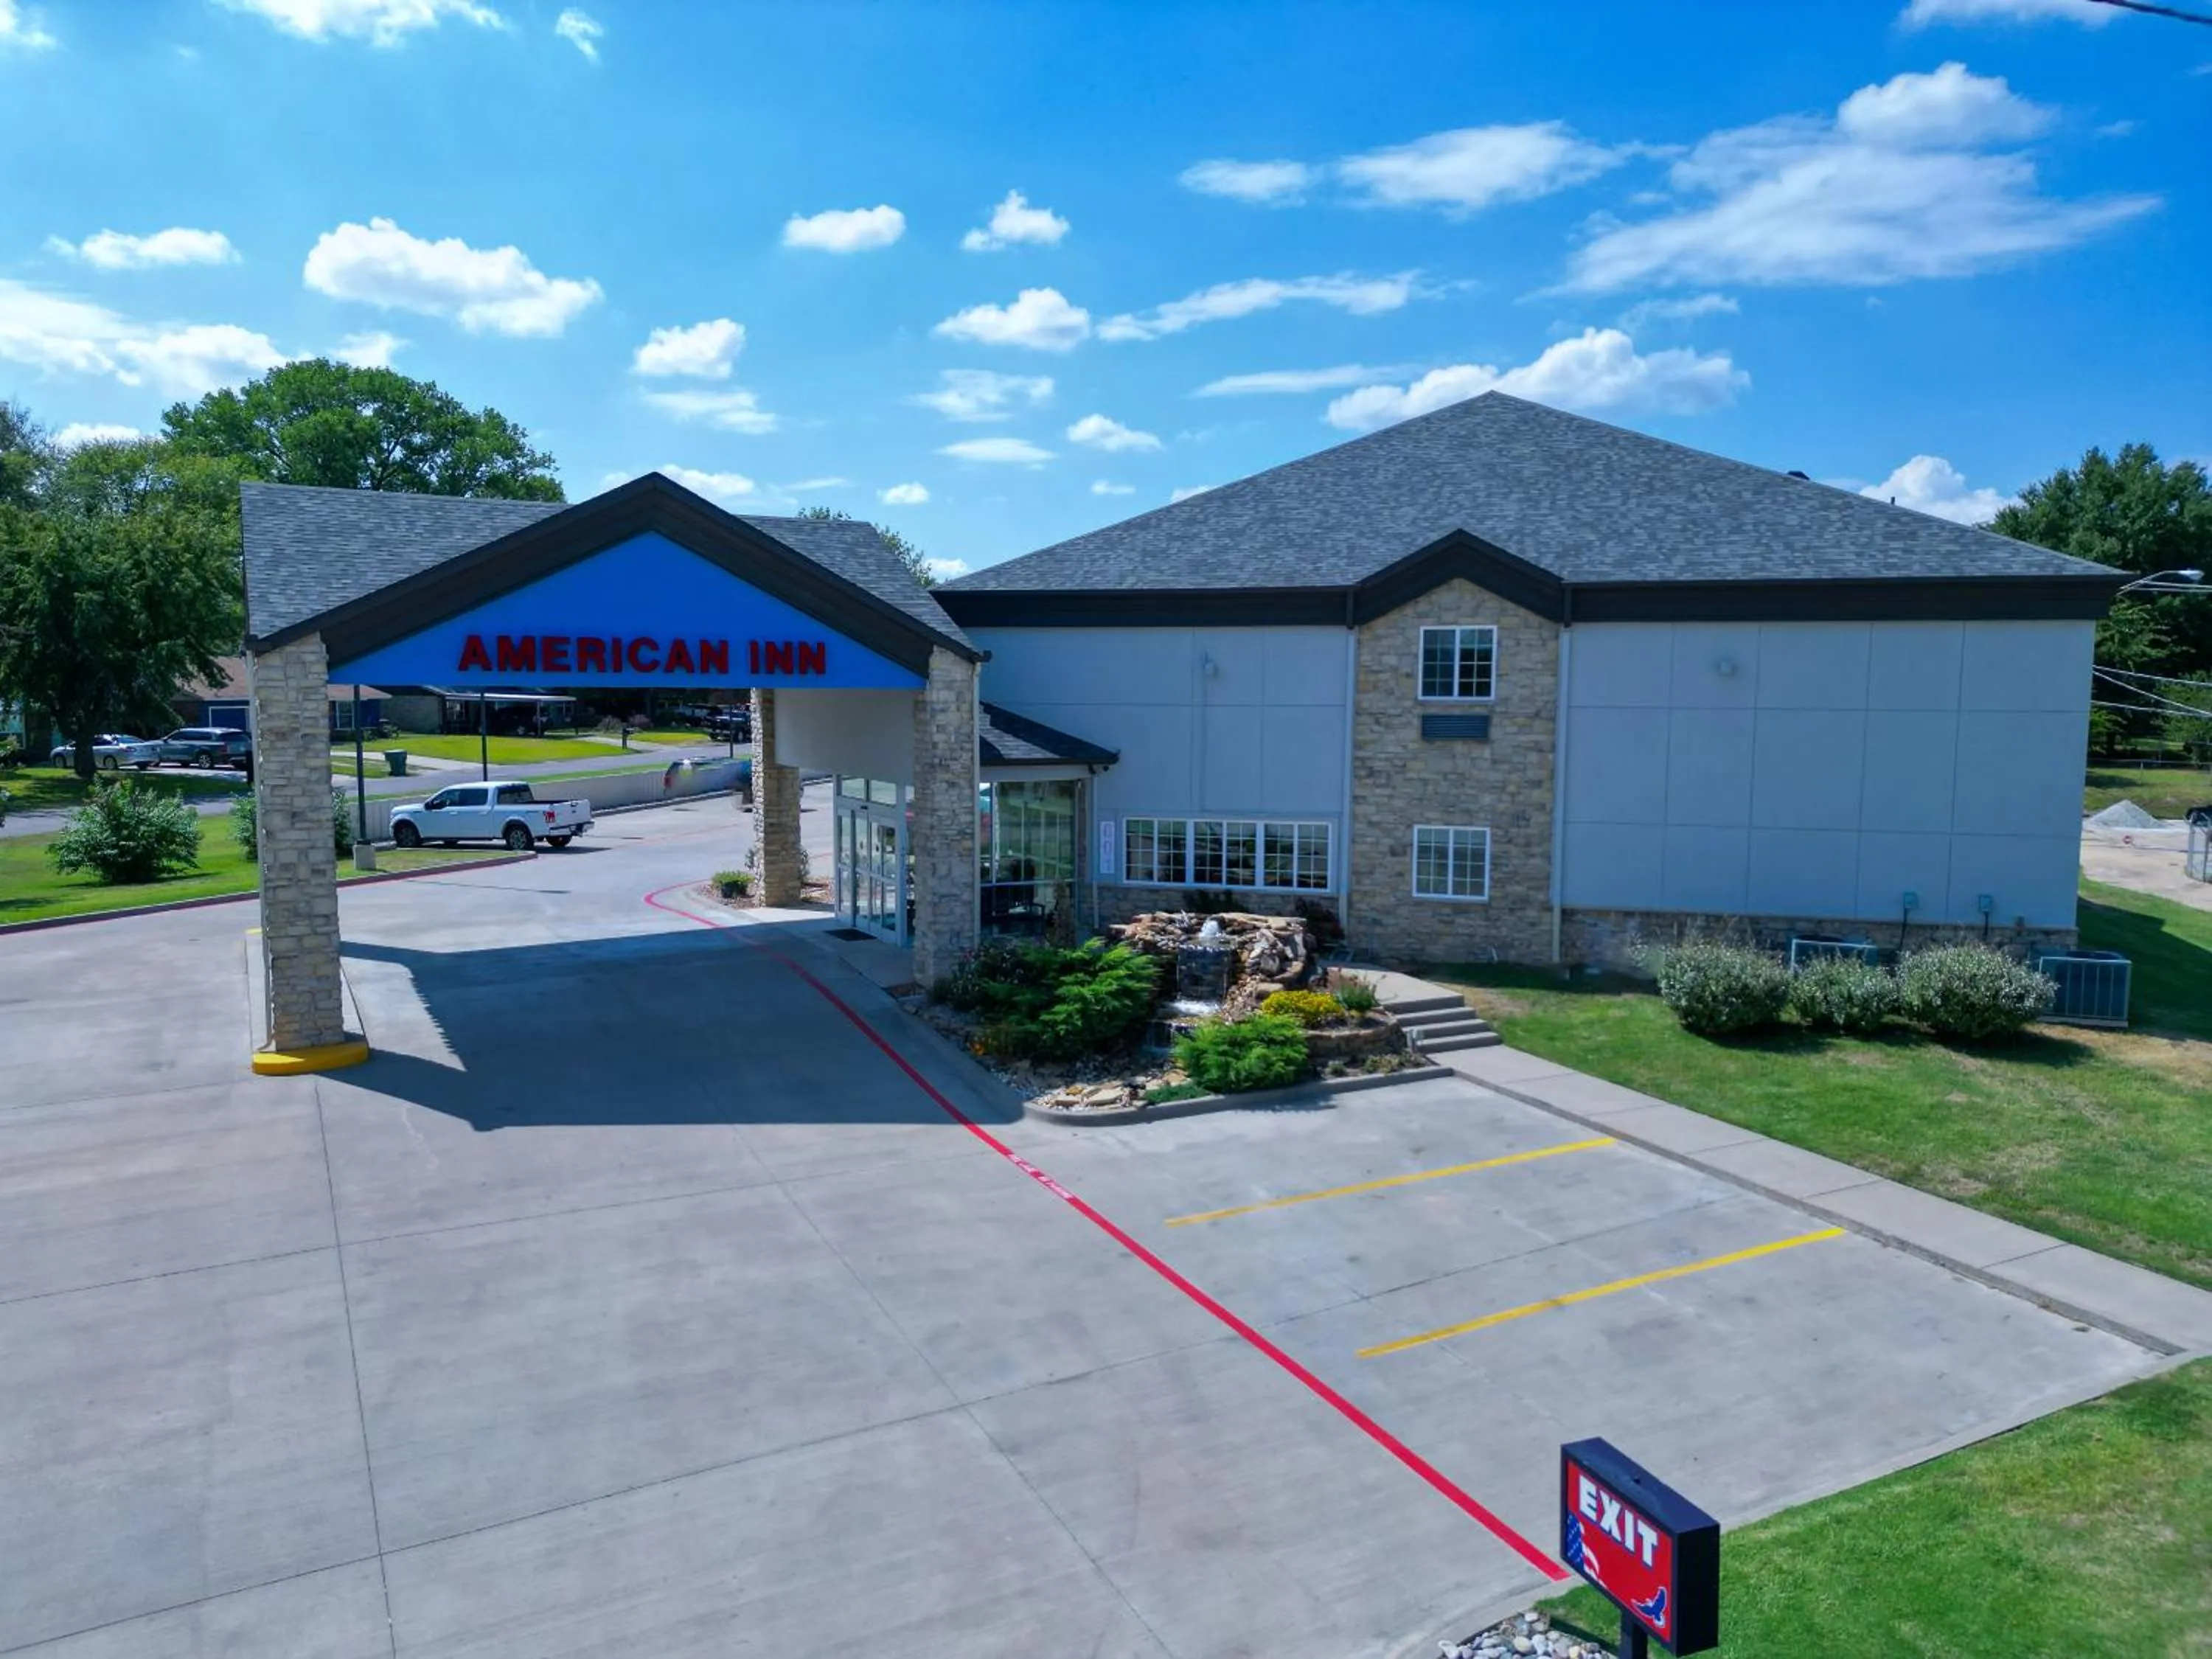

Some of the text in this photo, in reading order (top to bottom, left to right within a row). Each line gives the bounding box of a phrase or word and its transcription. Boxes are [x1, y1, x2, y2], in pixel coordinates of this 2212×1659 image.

[459, 635, 827, 675] AMERICAN INN
[1579, 1474, 1658, 1567] EXIT
